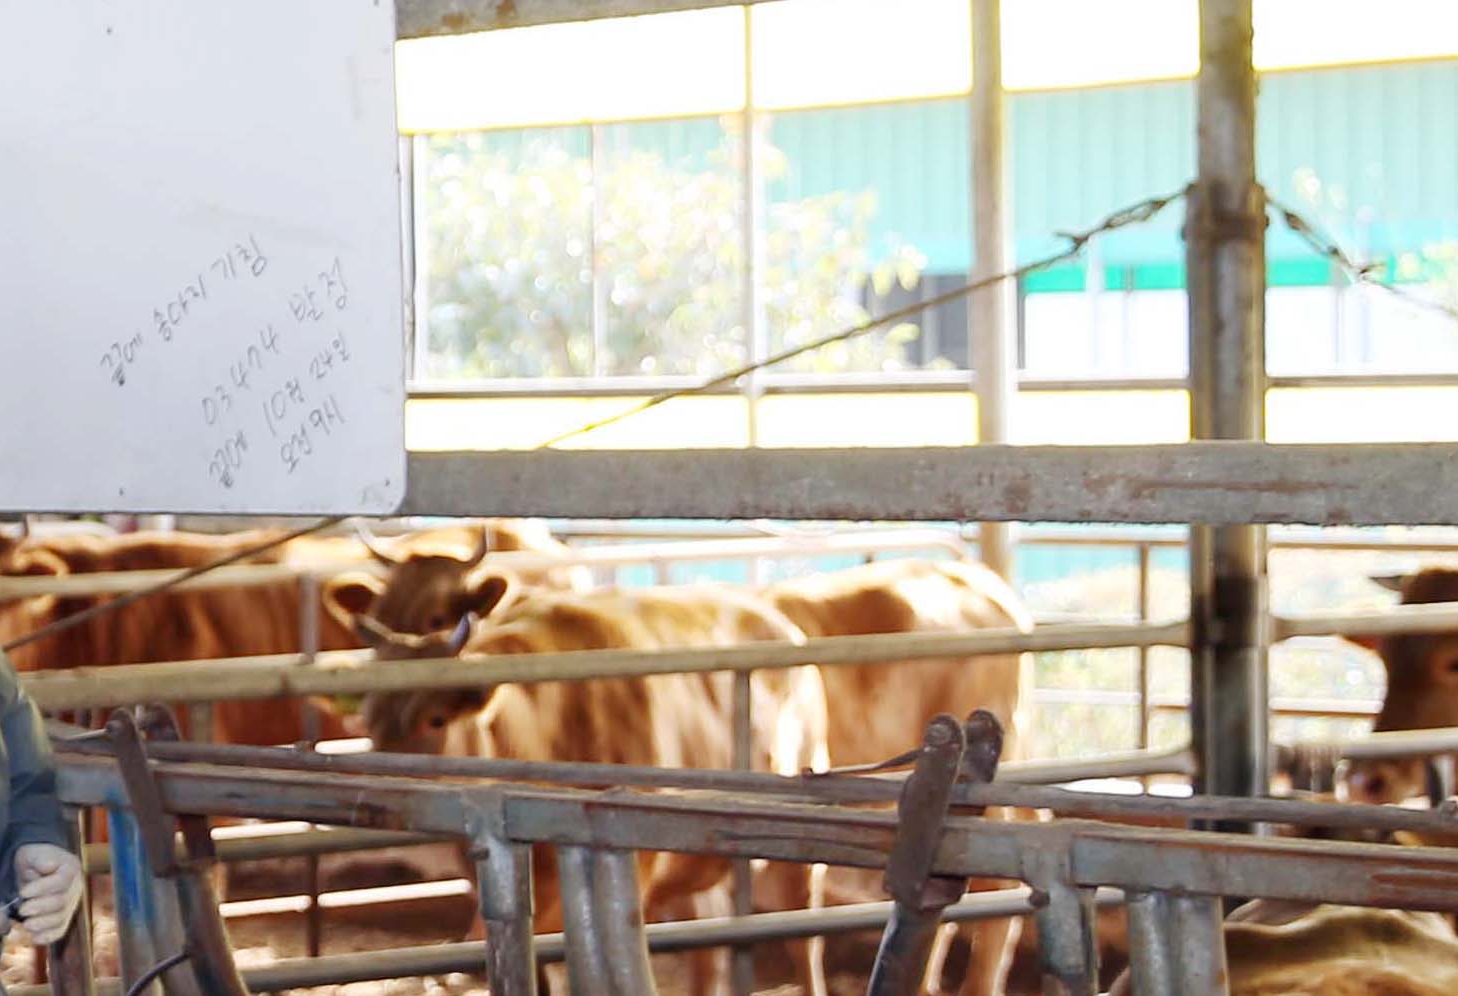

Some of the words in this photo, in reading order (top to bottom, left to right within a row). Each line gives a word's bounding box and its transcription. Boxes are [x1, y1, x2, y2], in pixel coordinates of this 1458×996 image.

[201, 323, 279, 425] 03474
[309, 330, 350, 380] 24일
[309, 394, 345, 435] 9시
